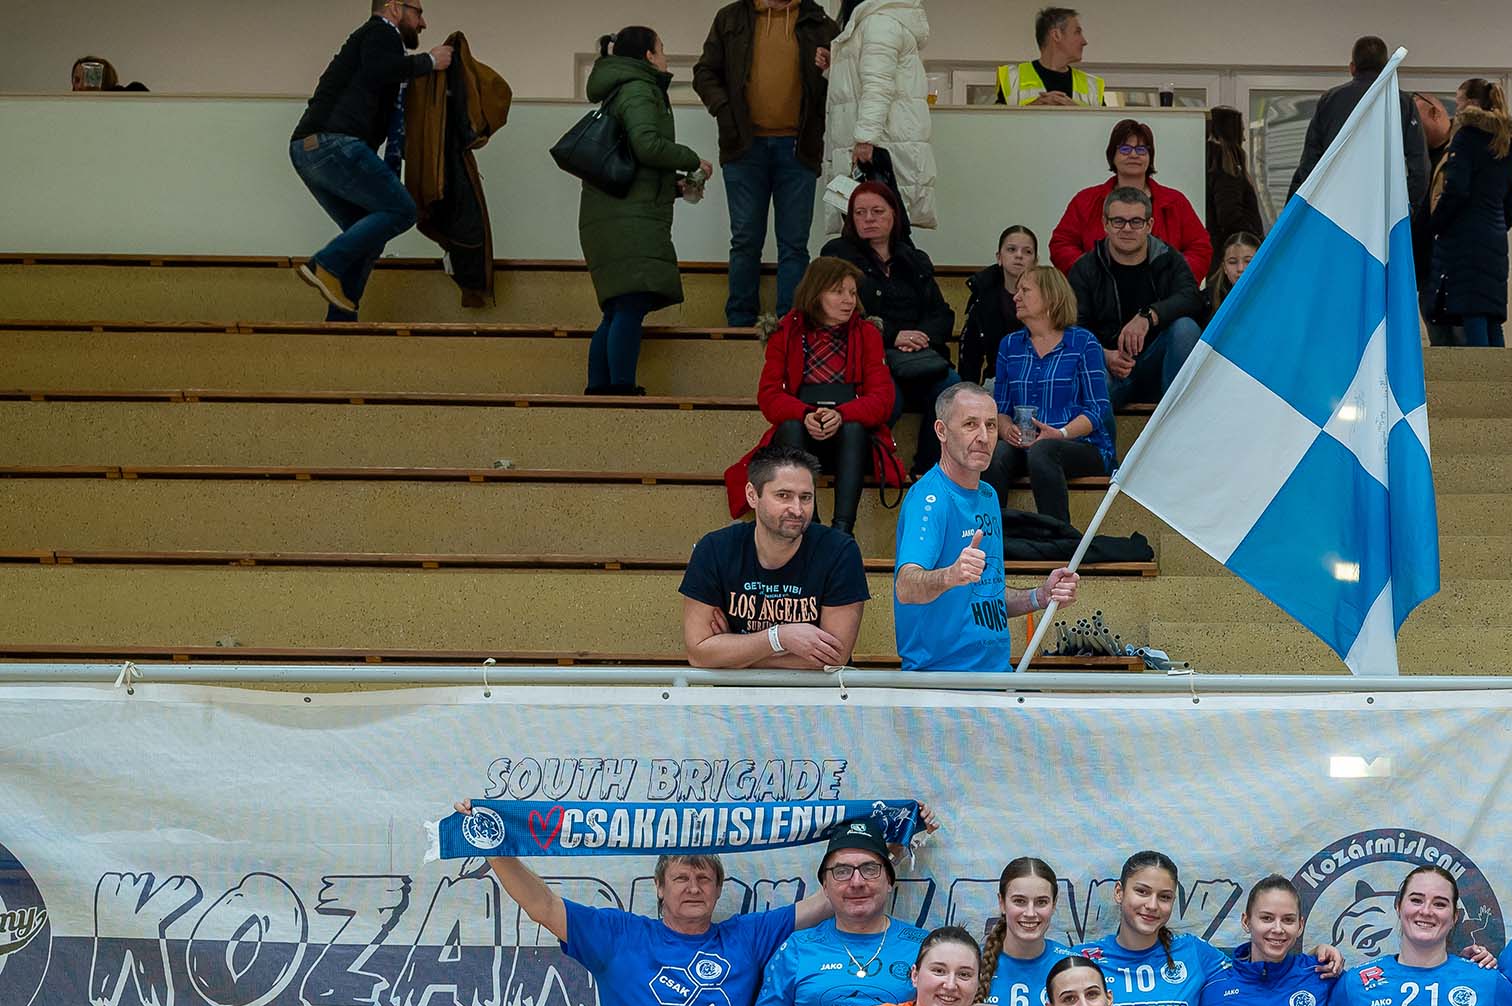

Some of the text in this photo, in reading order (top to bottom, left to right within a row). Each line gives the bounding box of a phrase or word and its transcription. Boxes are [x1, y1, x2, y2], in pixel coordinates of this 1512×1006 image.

[729, 591, 818, 622] LOS ANGELES
[971, 599, 1008, 632] HONS
[483, 758, 849, 800] SOUTH BRIGADE
[658, 975, 691, 999] CSAK
[1118, 965, 1152, 993] 10
[1223, 988, 1240, 996] JAKO
[1370, 998, 1392, 1006] JAKO
